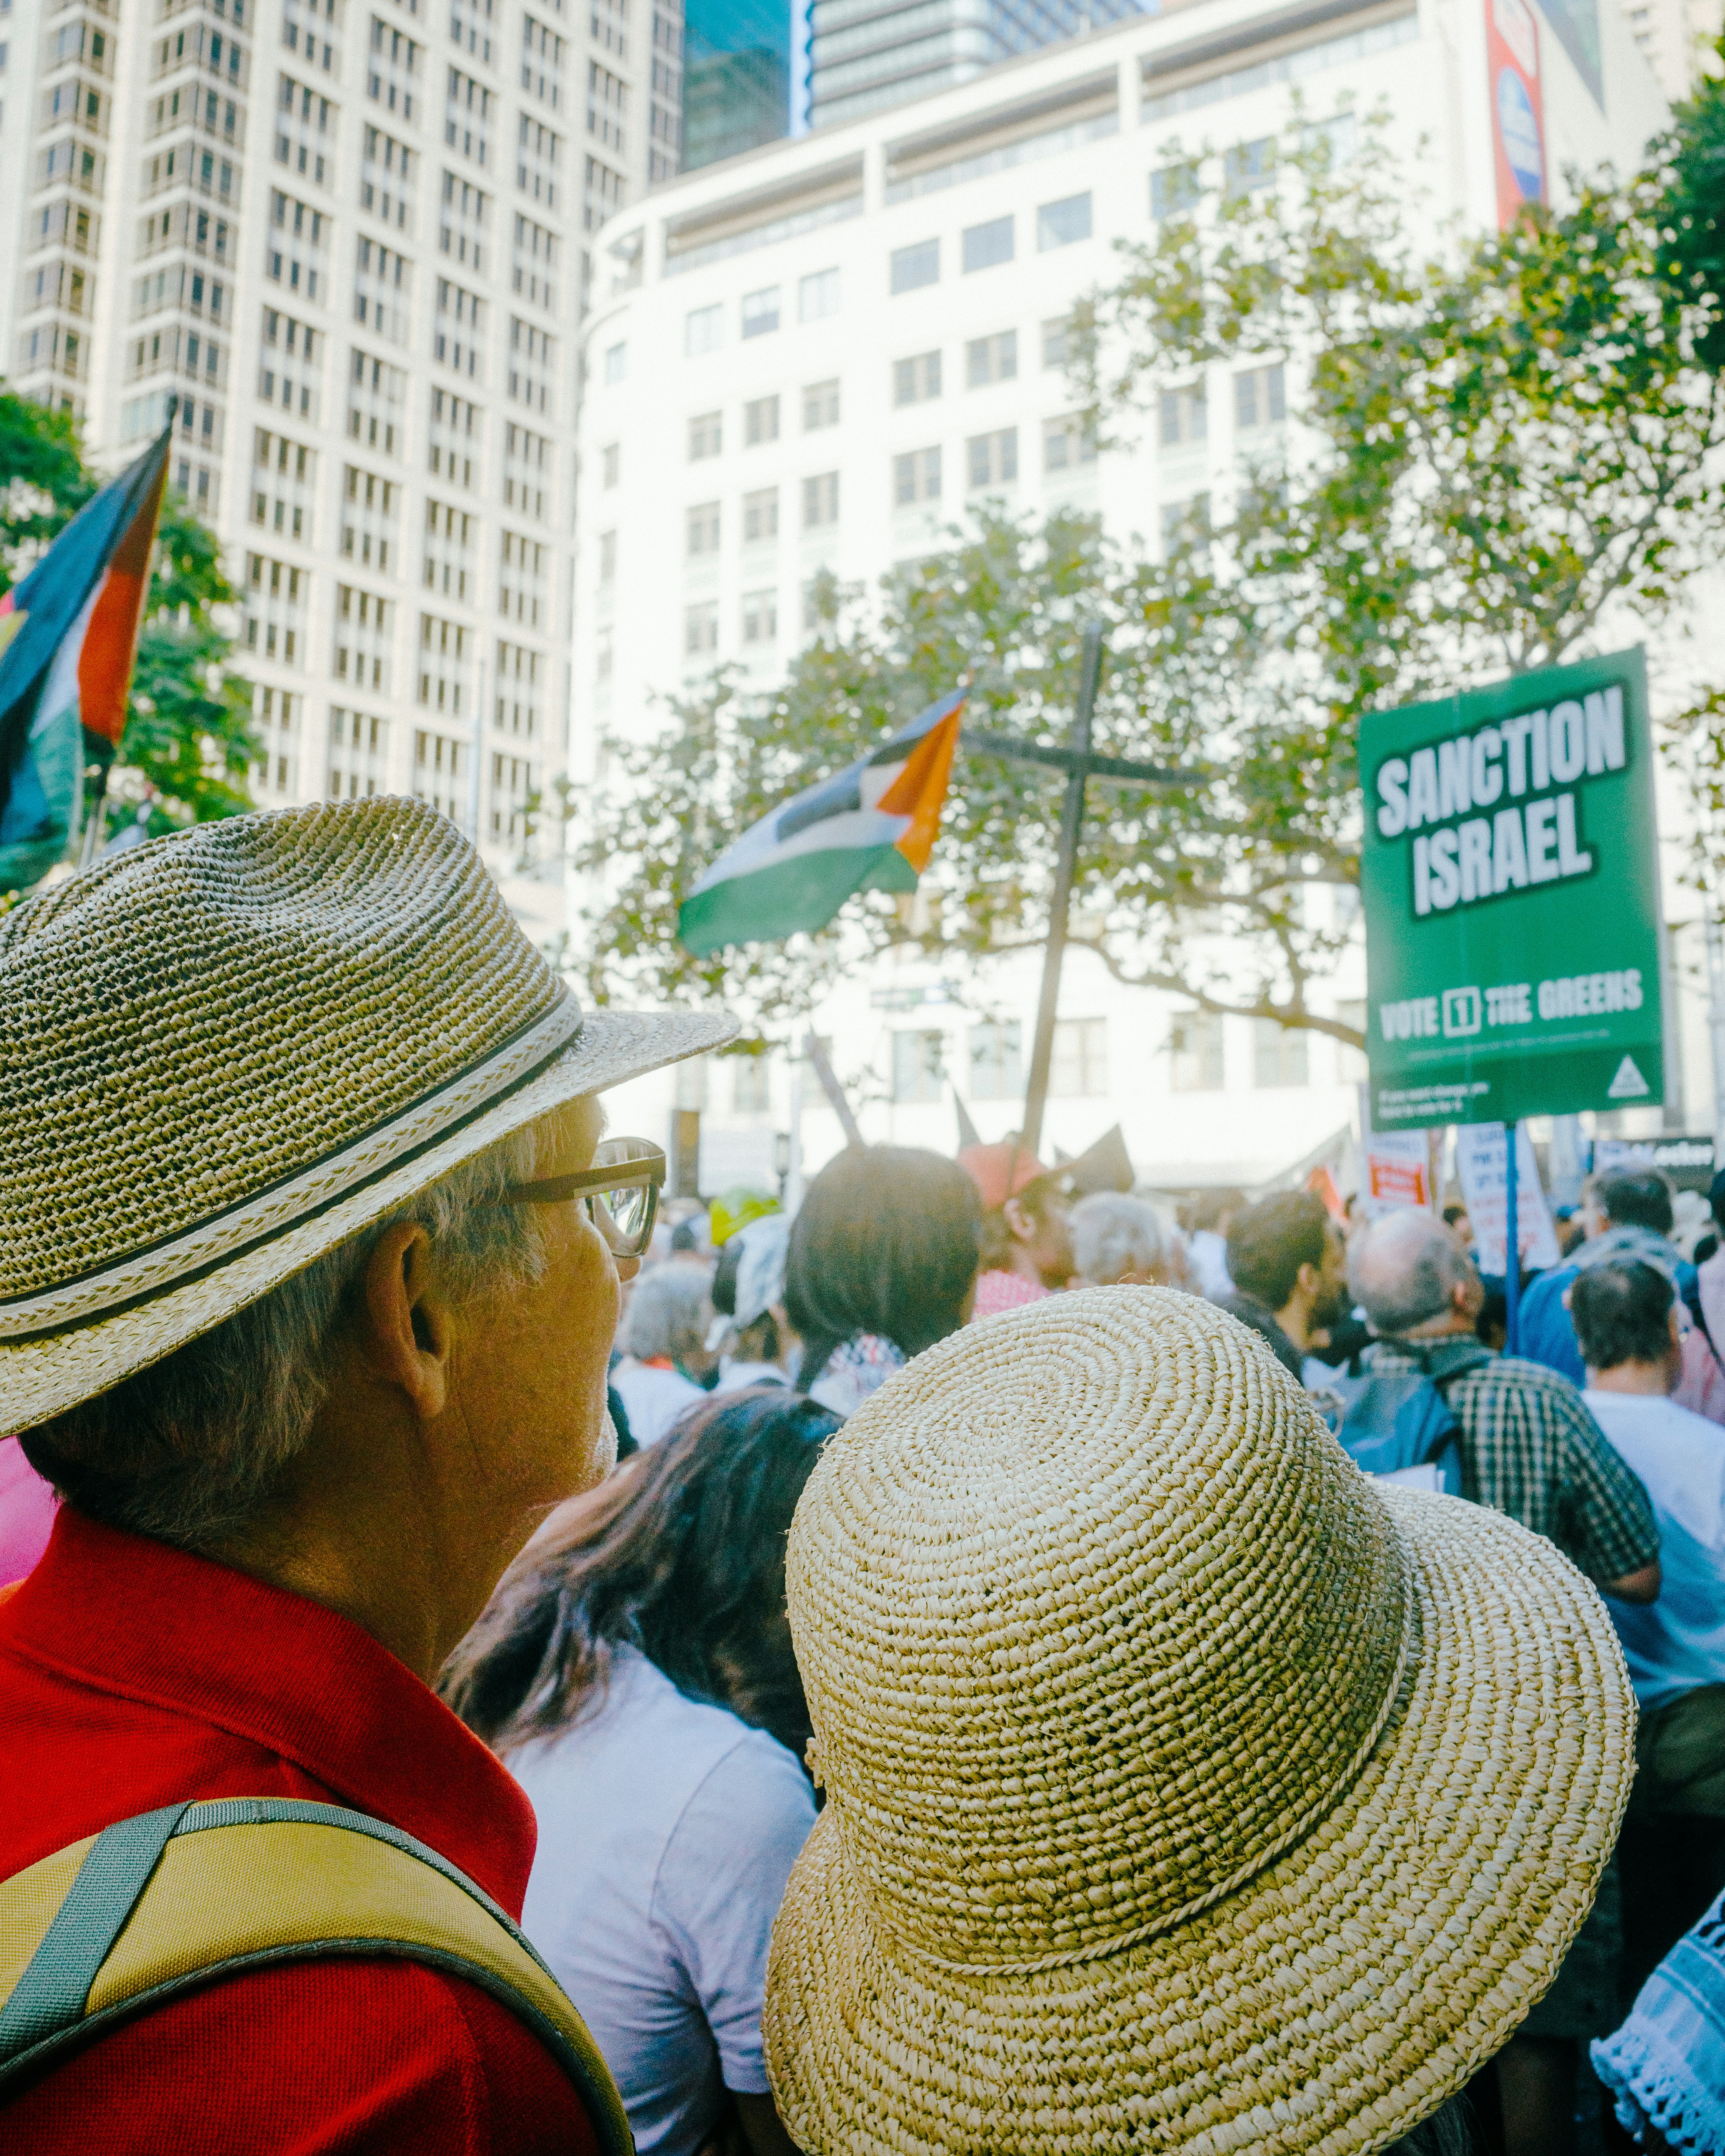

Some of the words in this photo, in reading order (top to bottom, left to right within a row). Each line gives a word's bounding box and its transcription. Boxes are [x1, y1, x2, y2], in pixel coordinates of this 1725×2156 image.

[1378, 686, 1626, 837] SANCTION
[1413, 793, 1593, 915] ISRAEL
[1381, 997, 1439, 1041] VOTE
[1484, 983, 1533, 1026] THE
[1538, 969, 1643, 1020] GREENS
